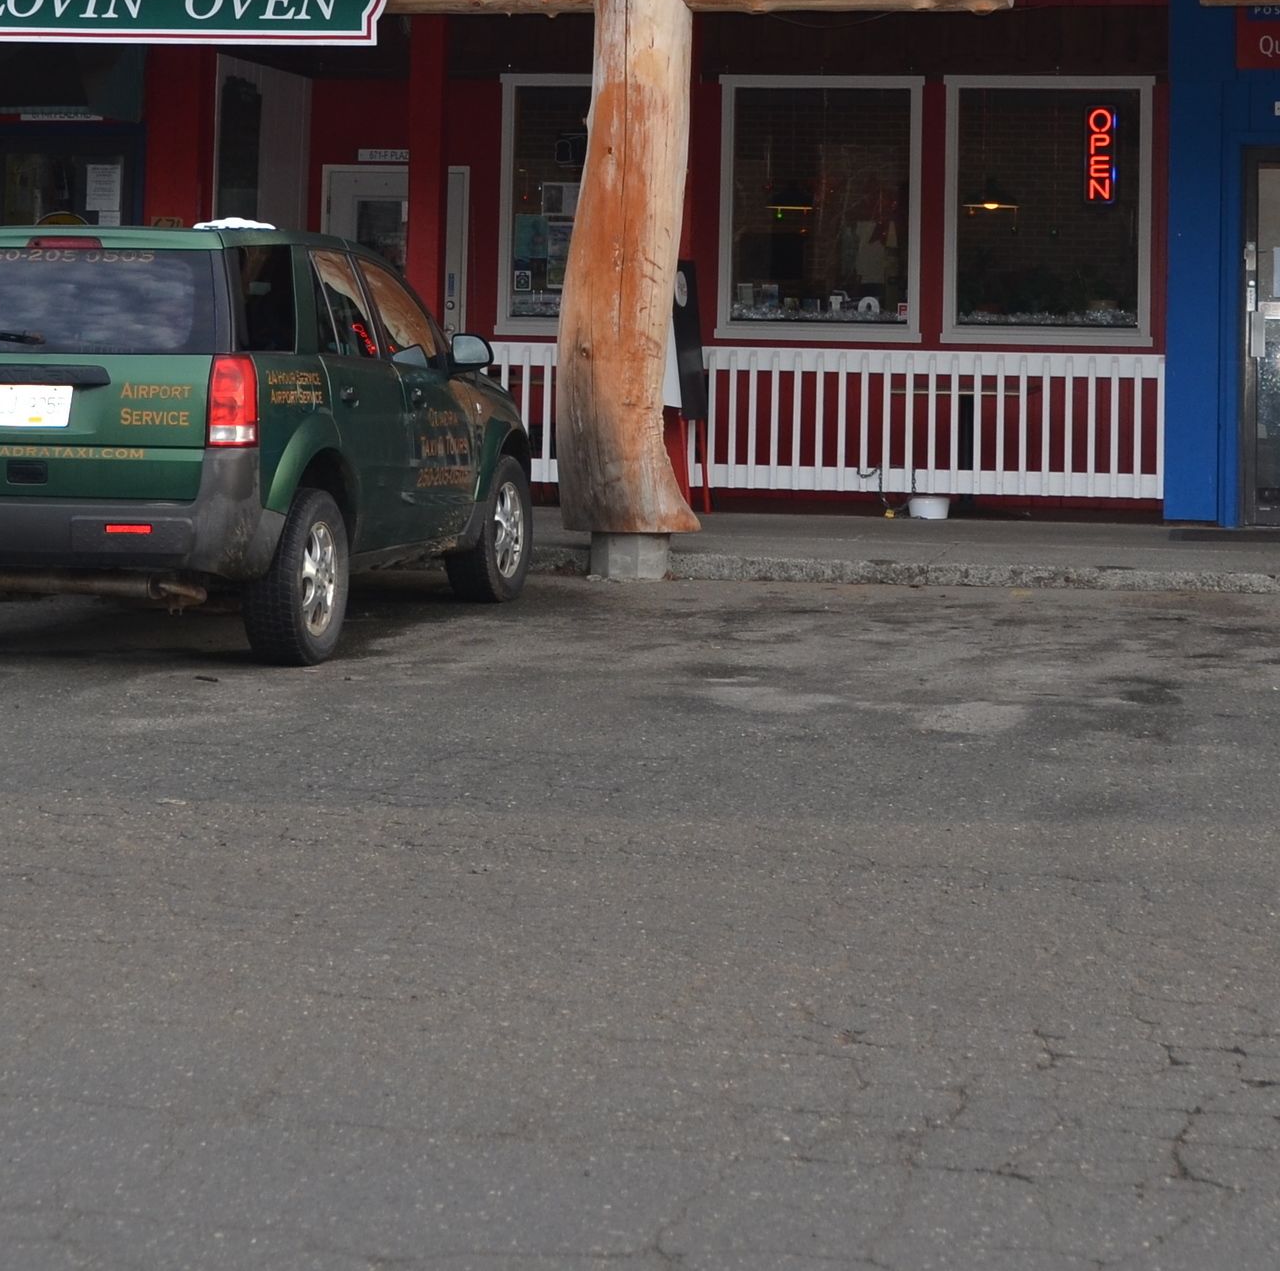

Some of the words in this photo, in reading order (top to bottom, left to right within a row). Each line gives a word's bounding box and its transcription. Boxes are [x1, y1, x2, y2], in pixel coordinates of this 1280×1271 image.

[390, 151, 409, 160] PLAZ
[1089, 109, 1112, 200] OPEN
[121, 383, 192, 400] AIRPORT
[121, 408, 190, 426] SERVICE
